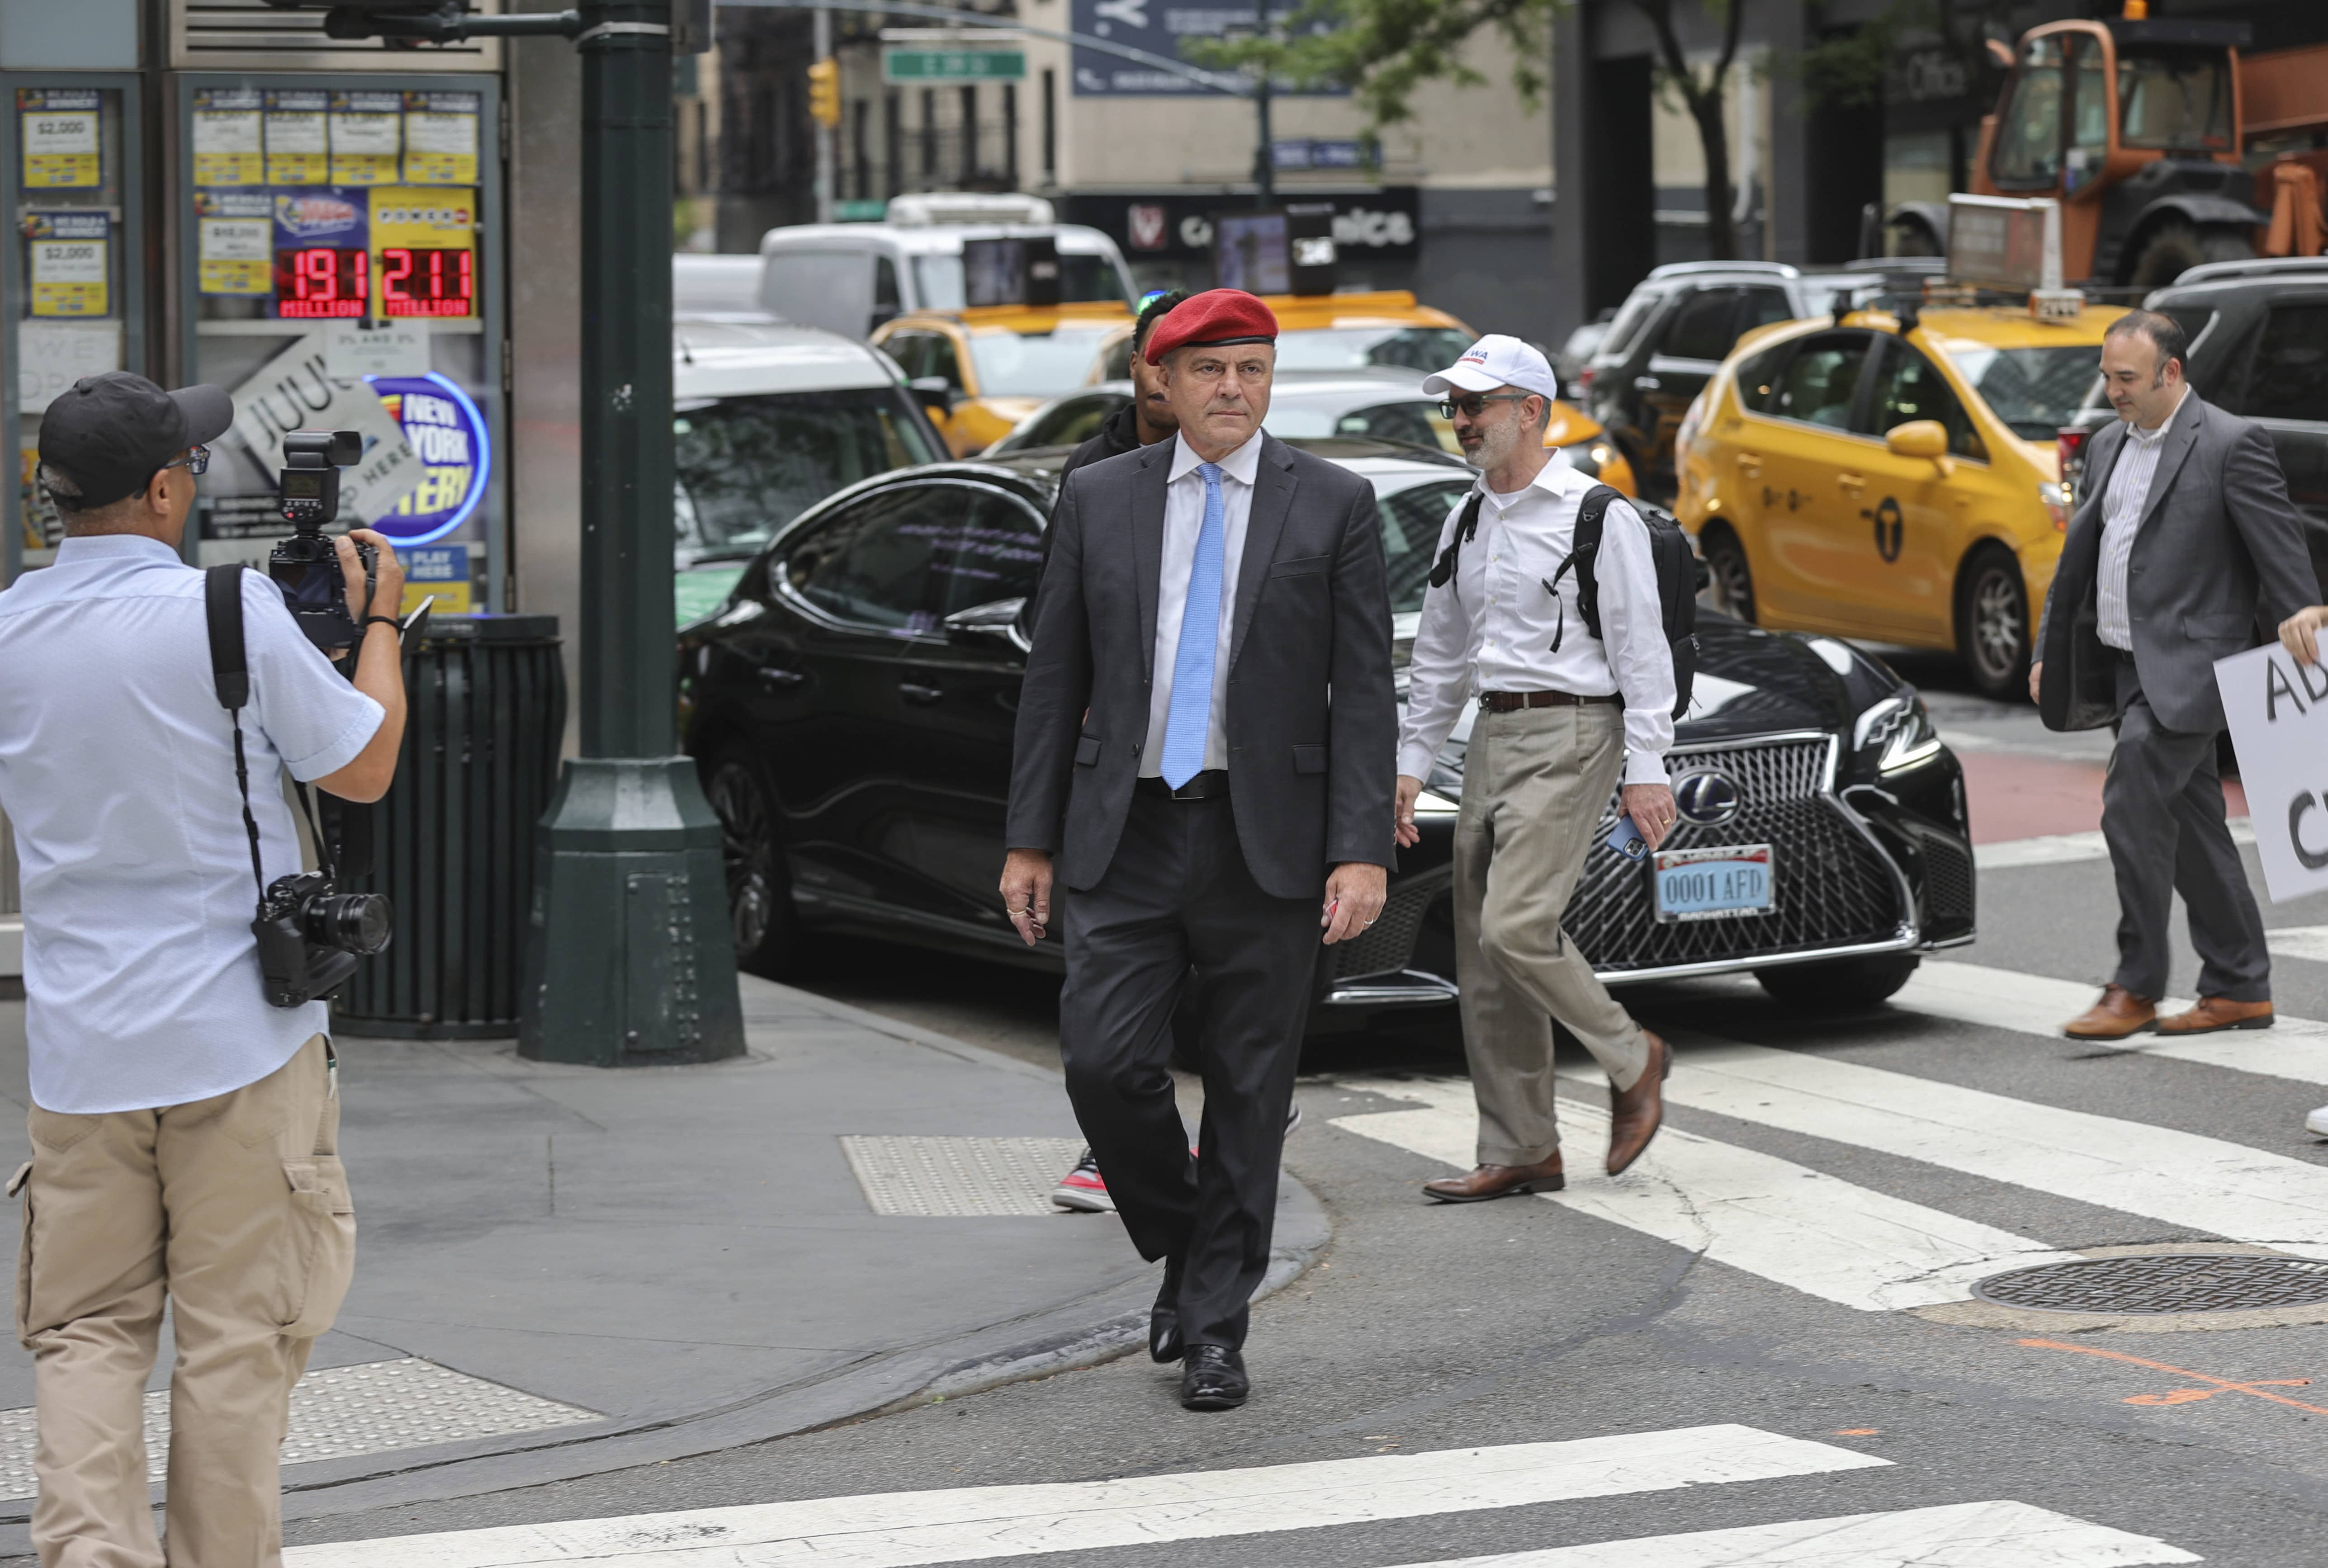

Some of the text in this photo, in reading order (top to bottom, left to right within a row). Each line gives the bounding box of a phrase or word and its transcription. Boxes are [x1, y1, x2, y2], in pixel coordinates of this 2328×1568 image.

[37, 119, 85, 135] $2,000
[46, 246, 94, 261] $2,000
[295, 249, 367, 301] 191
[382, 249, 472, 301] 211
[280, 300, 364, 317] MILLION
[386, 299, 468, 316] MILLION
[404, 392, 457, 427] NEW
[406, 423, 469, 464] YORK
[362, 442, 415, 487] HERE
[412, 551, 451, 564] PLAY
[412, 564, 454, 579] HERE
[2289, 789, 2328, 869] C
[1666, 869, 1762, 904] 0001 AFD
